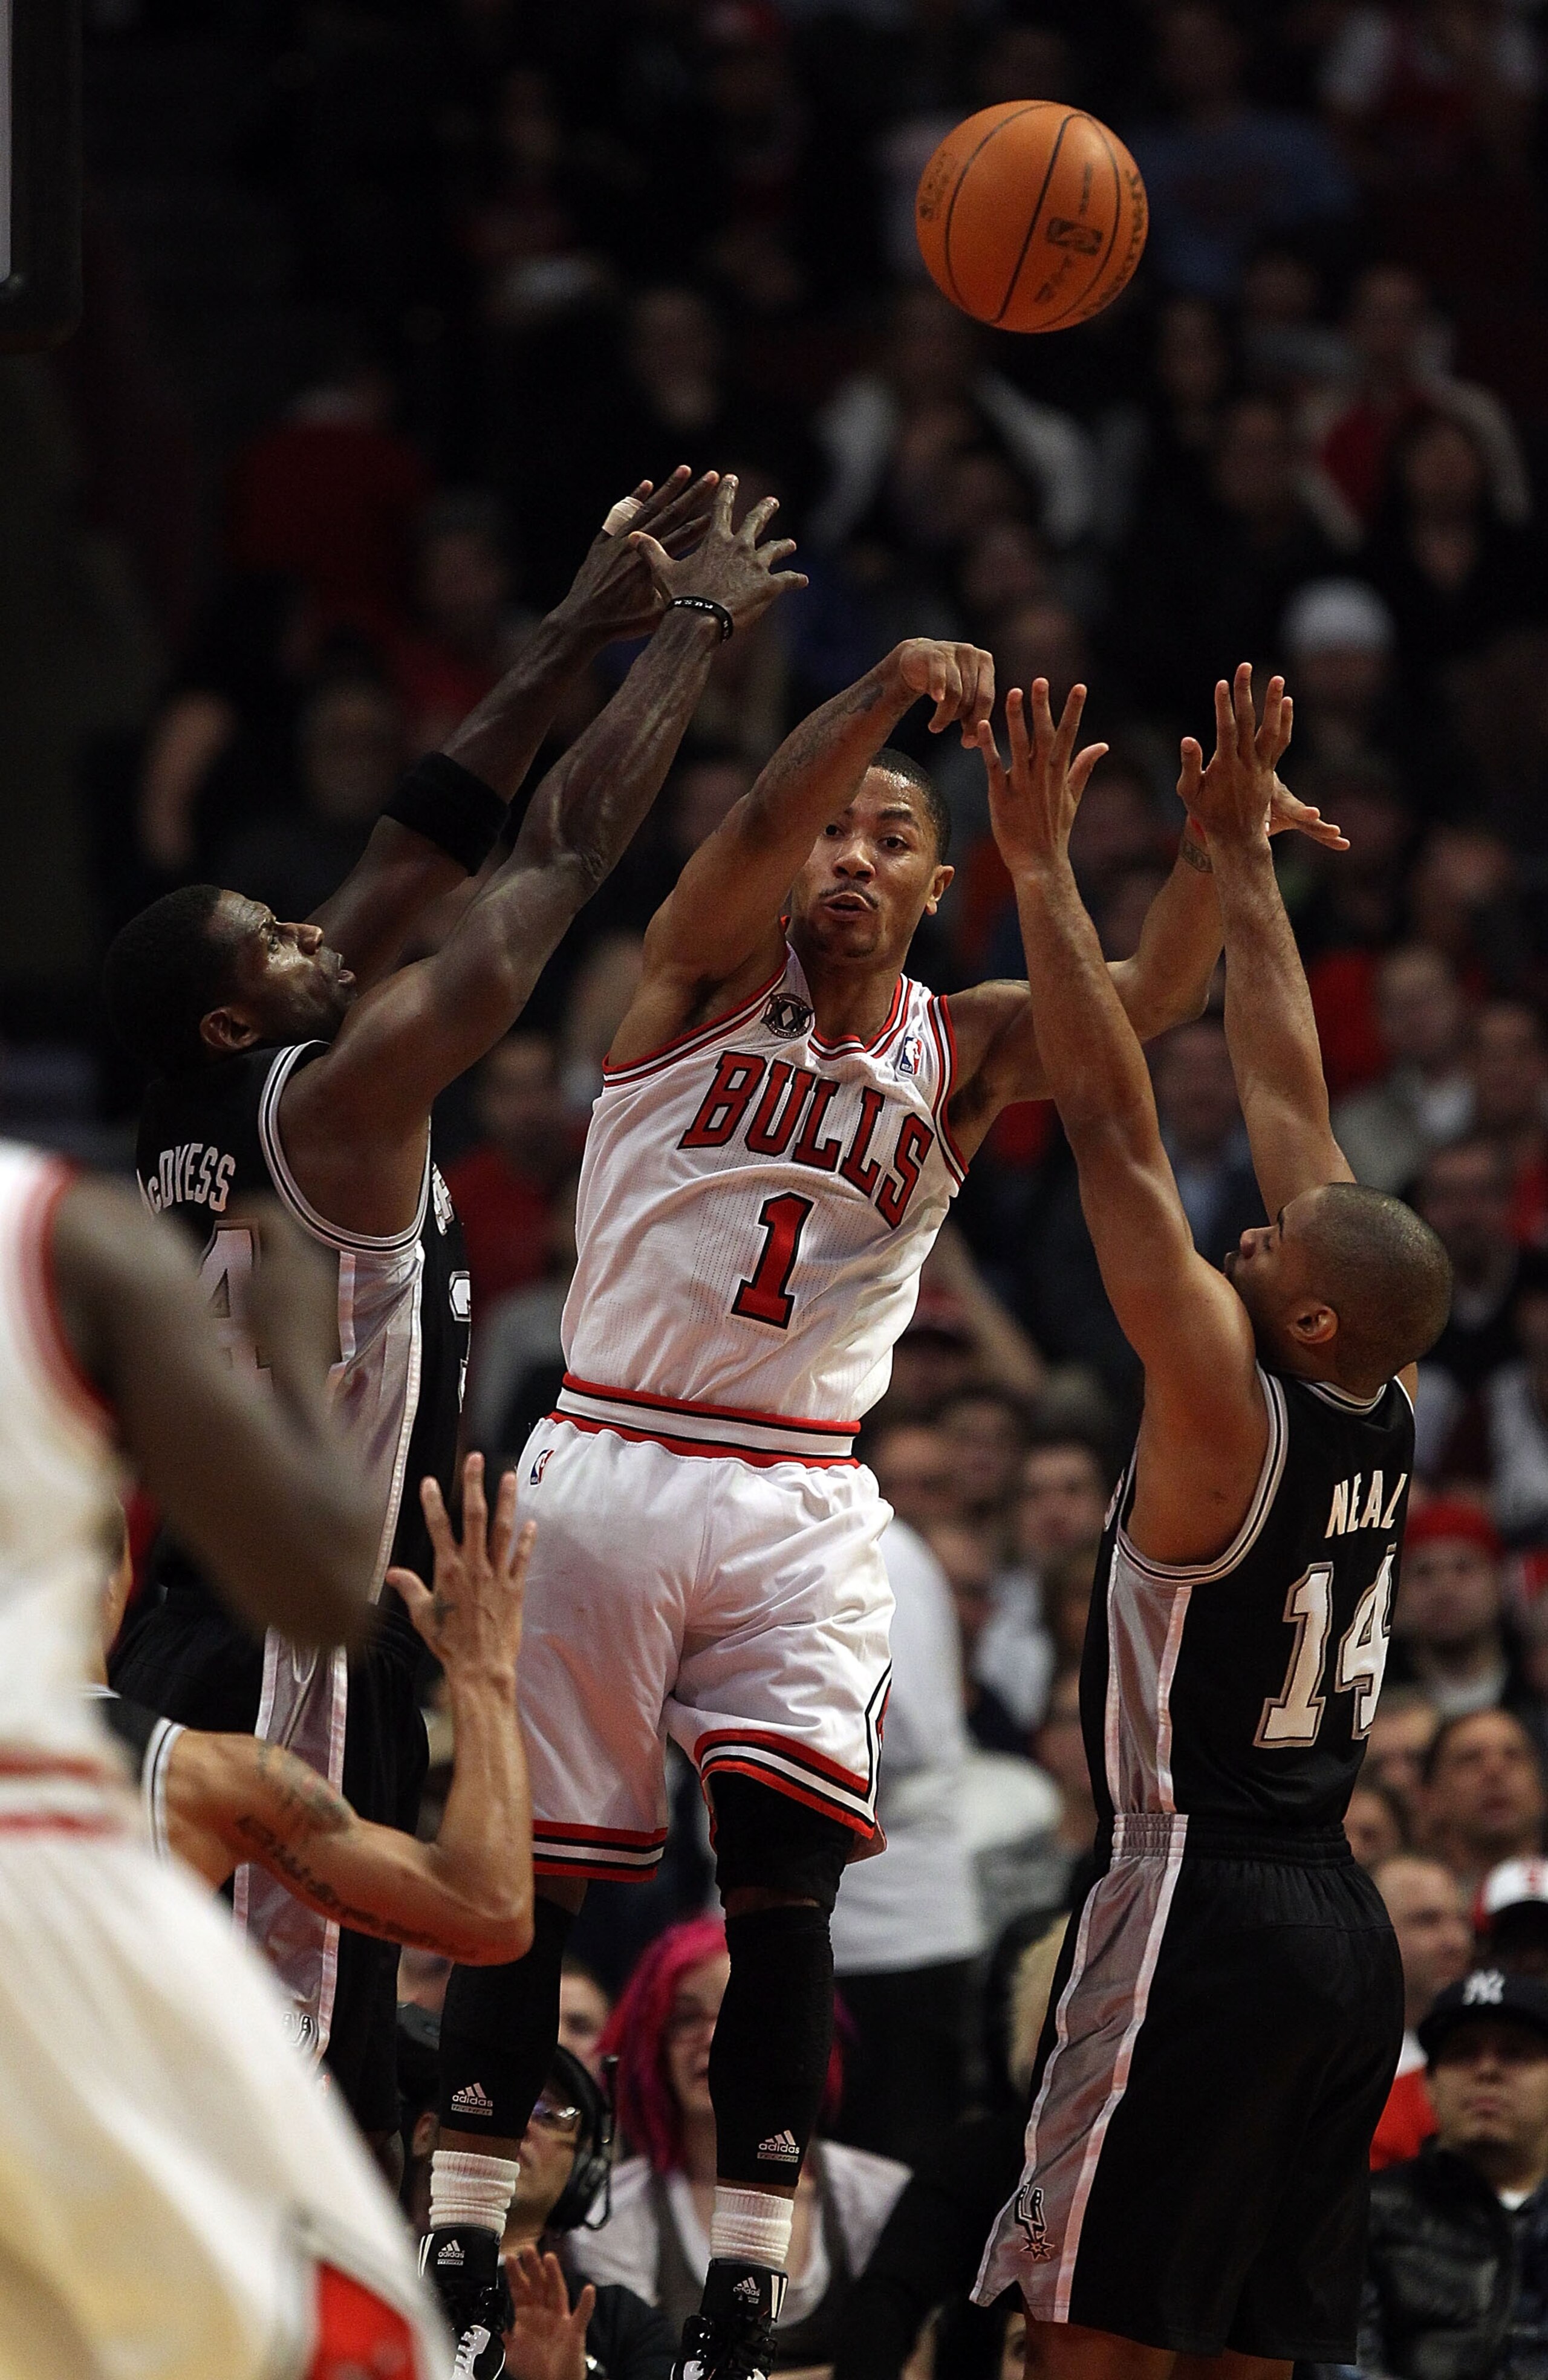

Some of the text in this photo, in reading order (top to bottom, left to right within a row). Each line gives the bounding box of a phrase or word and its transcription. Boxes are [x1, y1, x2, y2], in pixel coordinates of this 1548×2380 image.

[676, 1050, 935, 1230] BULLS
[730, 1191, 815, 1330] 1
[1324, 1470, 1408, 1539] NEAL
[1252, 1542, 1397, 1749] 14
[452, 2094, 493, 2107] adidas
[758, 2142, 800, 2154] adidas
